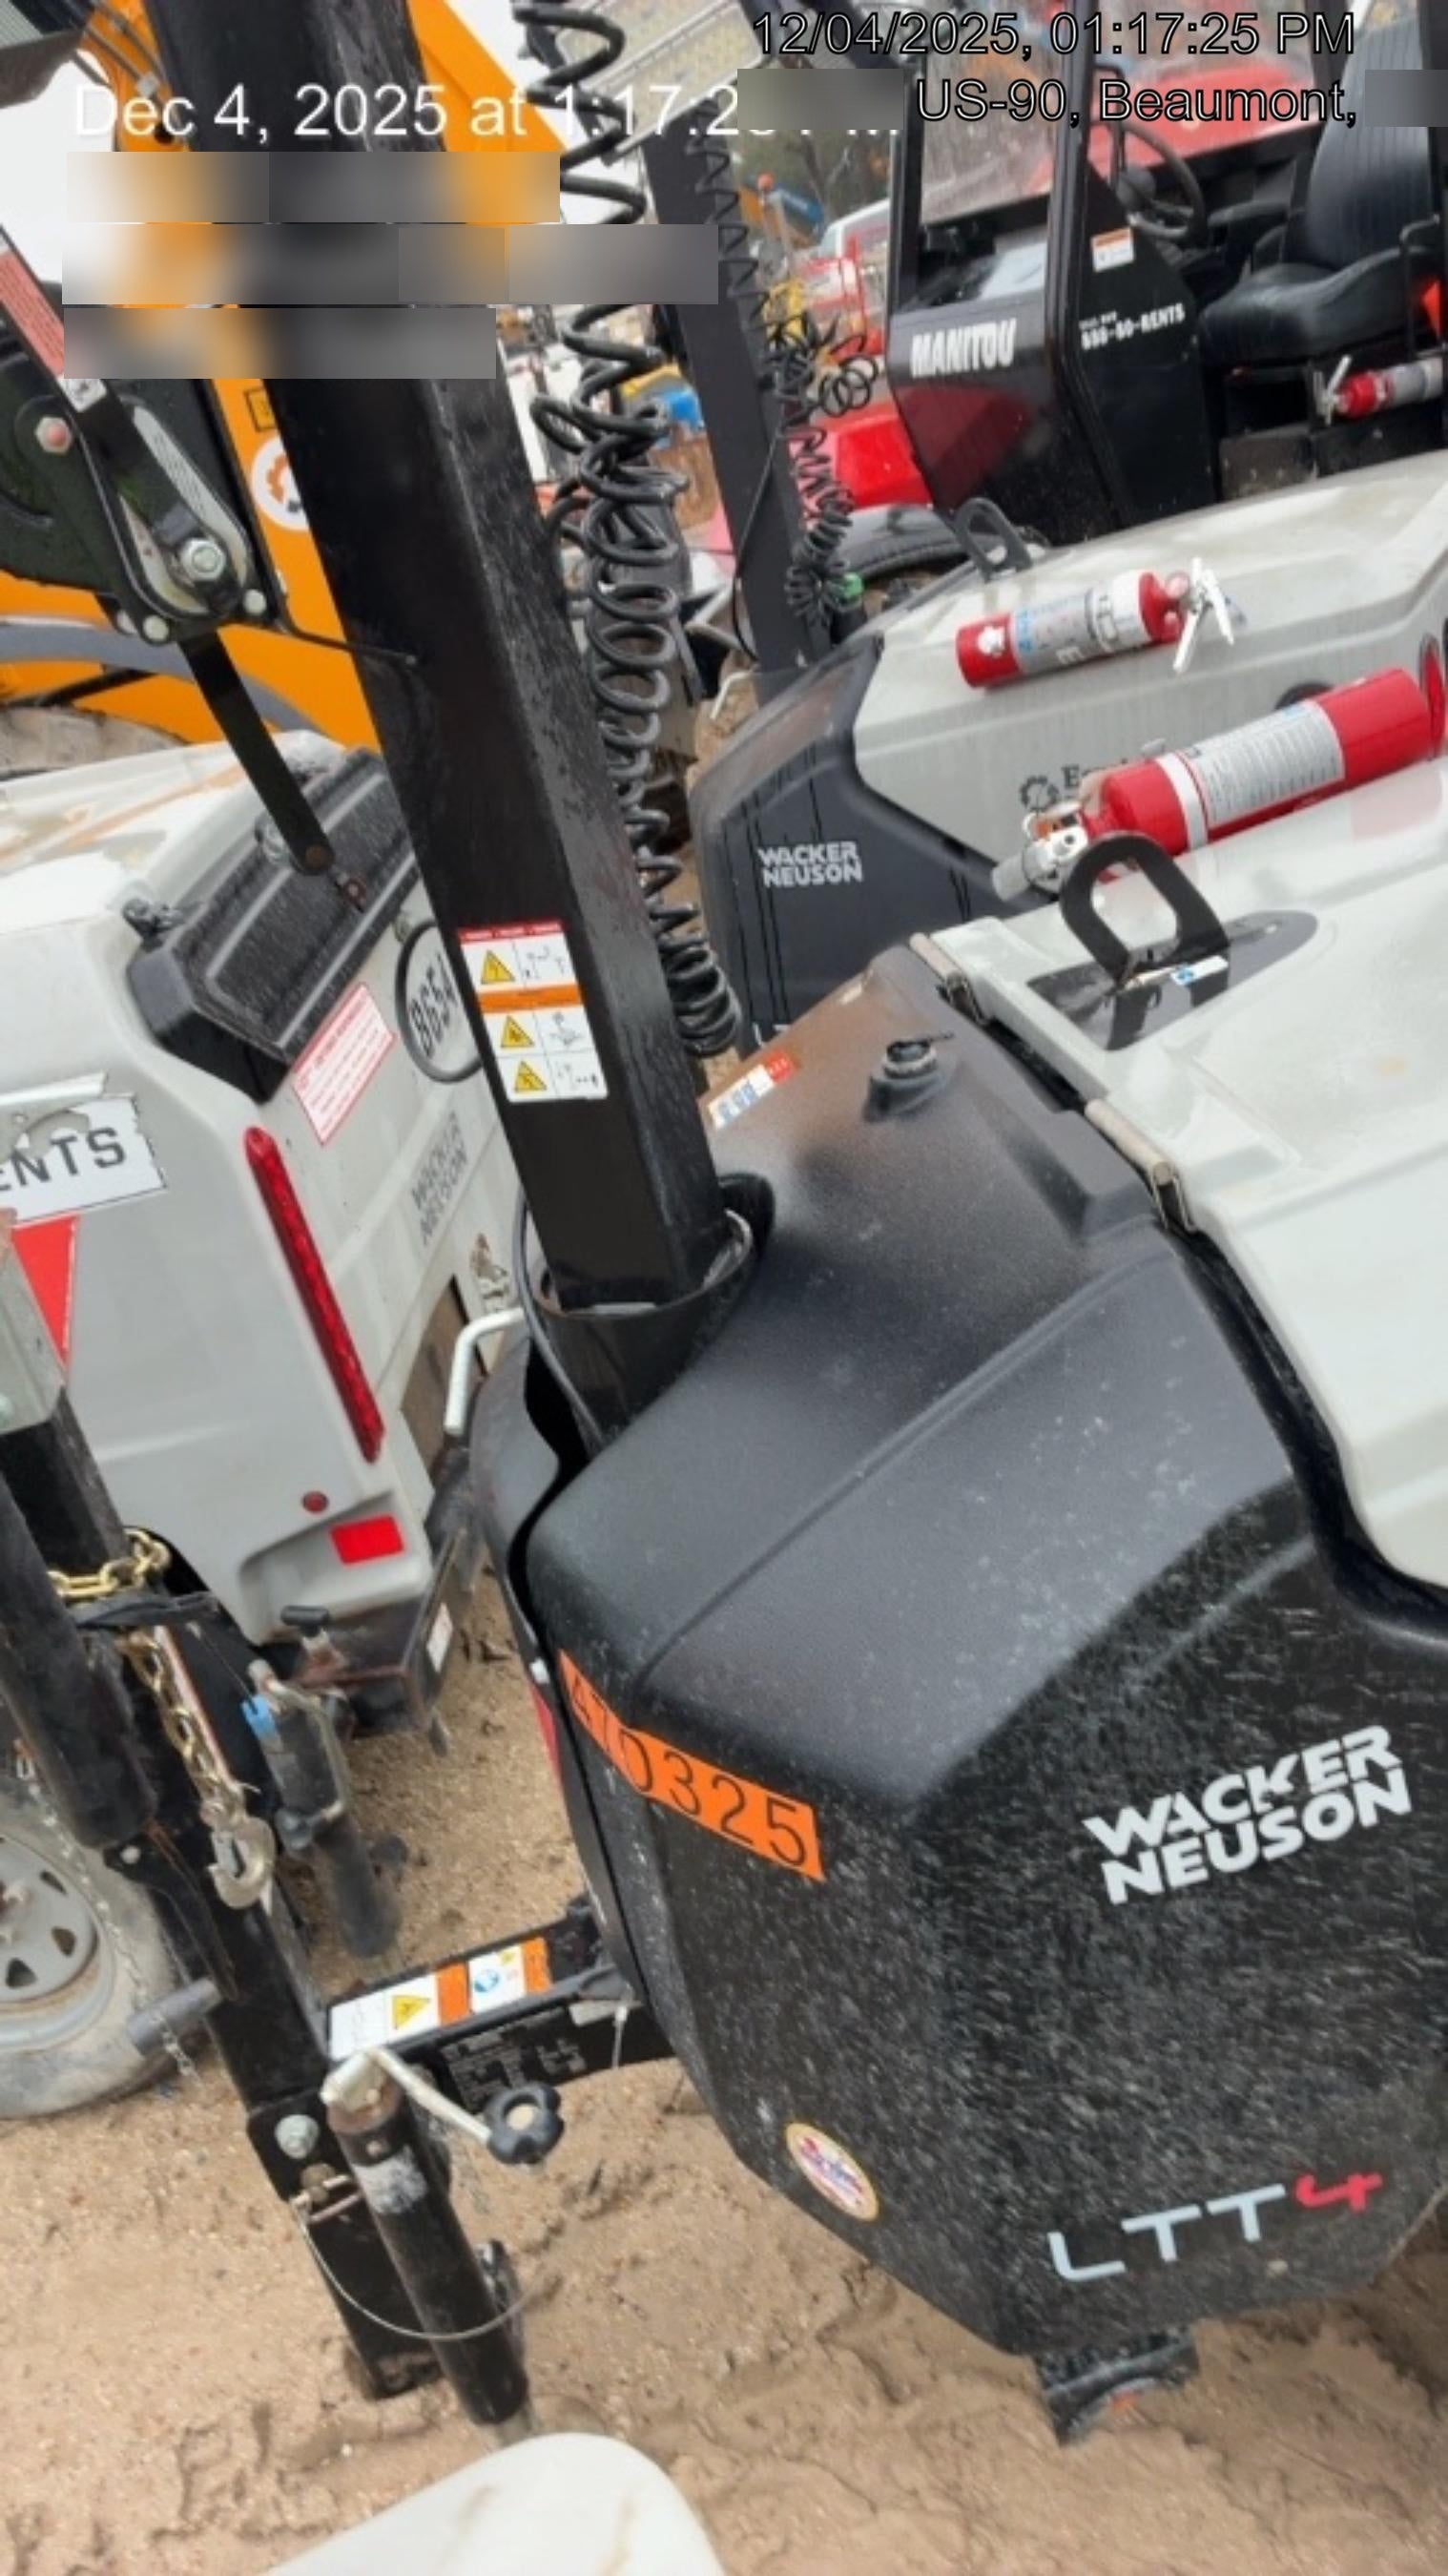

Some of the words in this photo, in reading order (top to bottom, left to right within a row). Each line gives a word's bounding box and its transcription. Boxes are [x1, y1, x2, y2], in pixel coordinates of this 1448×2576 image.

[911, 318, 1017, 378] MANITOU
[757, 841, 859, 866] WACKER
[763, 860, 863, 888] NEUSON
[1082, 1725, 1402, 1858] WACKER
[1101, 1768, 1412, 1905] NEUSON
[1047, 2172, 1383, 2282] LTT4
